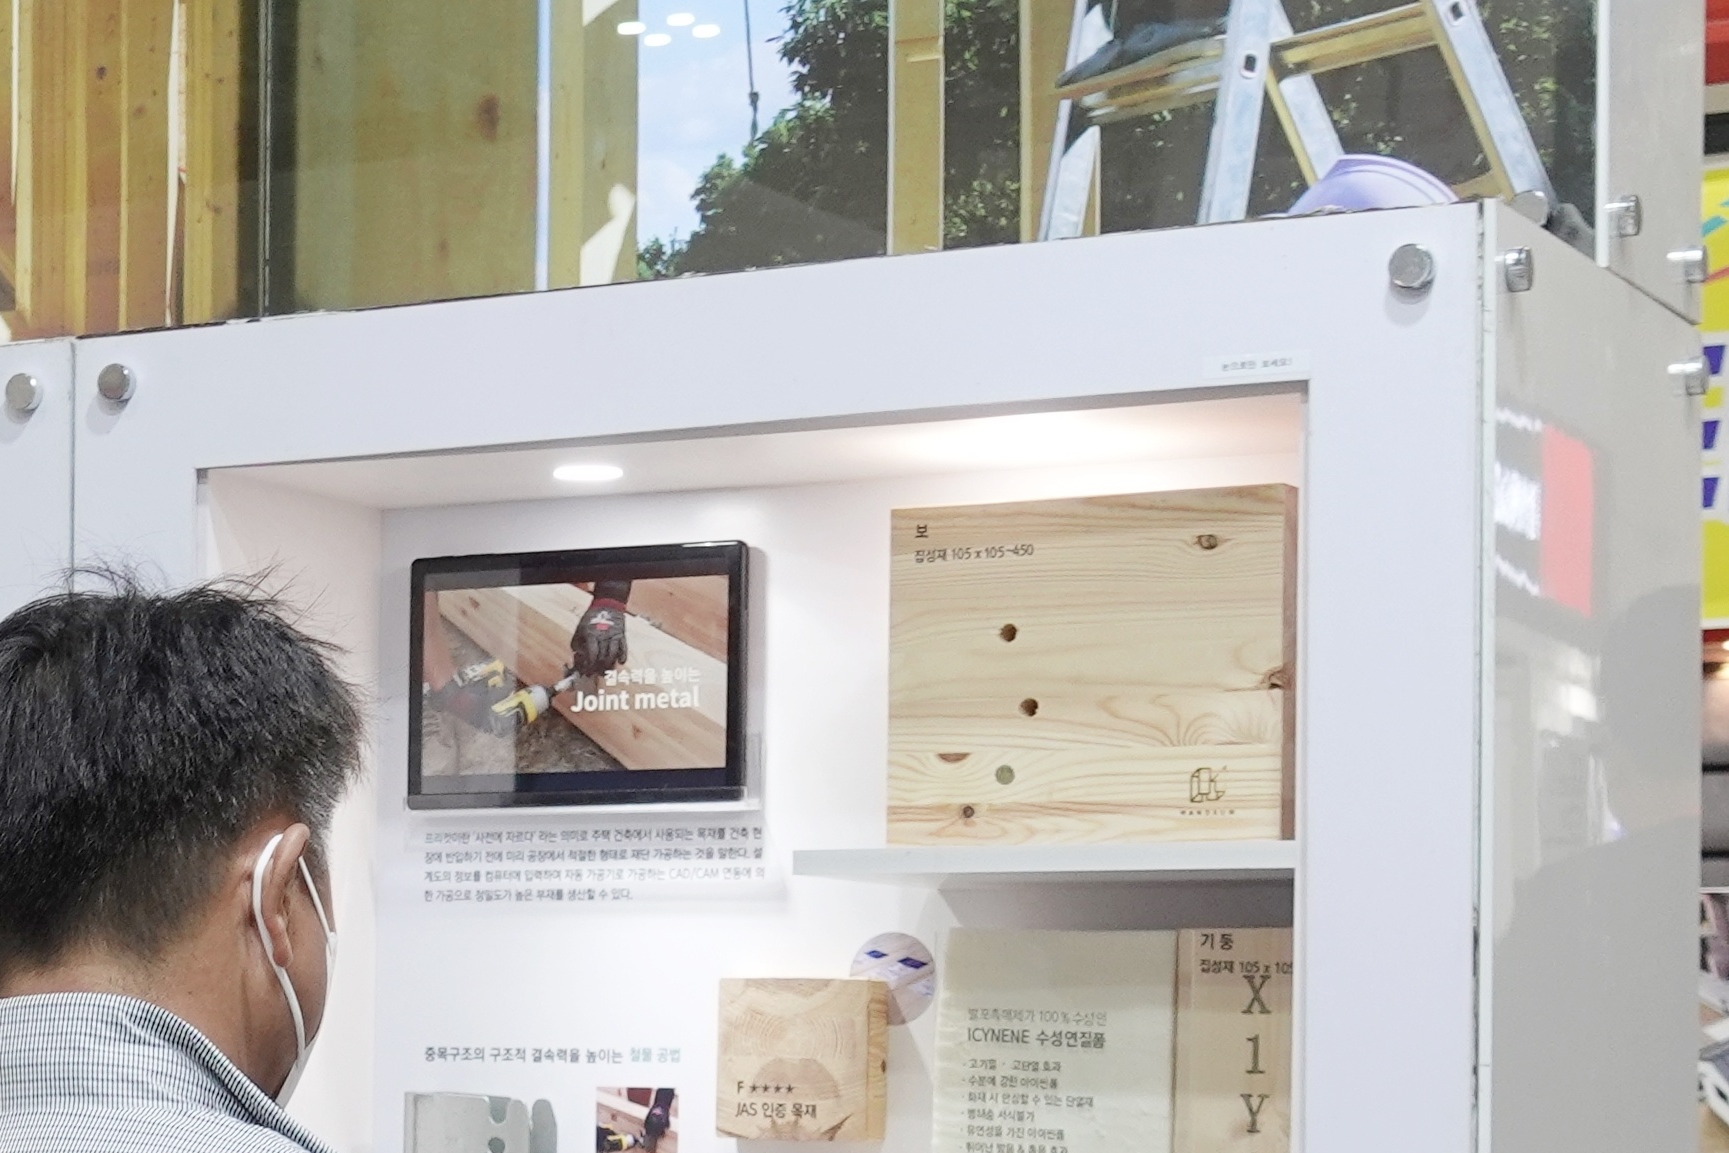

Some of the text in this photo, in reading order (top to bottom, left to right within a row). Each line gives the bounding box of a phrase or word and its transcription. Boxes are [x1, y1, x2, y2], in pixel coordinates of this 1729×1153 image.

[915, 524, 928, 538] 보
[914, 549, 947, 563] 집성재
[952, 547, 972, 560] 105
[604, 666, 702, 686] 결속력을 높이는
[570, 685, 700, 712] Joint metal
[591, 829, 612, 841] 주택
[614, 828, 652, 842] 건축에서
[655, 828, 693, 841] 사용되는
[697, 827, 726, 841] 목재를
[729, 827, 749, 840] 건축
[527, 850, 565, 862] 공장에서
[653, 848, 692, 861] 가공하는
[485, 870, 520, 883] 컴퓨터에
[564, 869, 583, 882] 자동
[628, 867, 665, 881] 가공하는
[669, 867, 720, 880] CAD/CAM
[436, 890, 472, 902] 가공으로
[599, 888, 608, 900] 수
[1199, 959, 1234, 974] 집성재
[1239, 961, 1260, 974] 105
[967, 1027, 1106, 1049] ICYNENE 수성연질폼
[424, 1047, 681, 1064] 중목구조의 구조적 결속력을 높이는 철물 공법
[1042, 1060, 1061, 1072] 효과
[990, 1092, 998, 1103] 시
[735, 1102, 817, 1119] JAS 인증 목재
